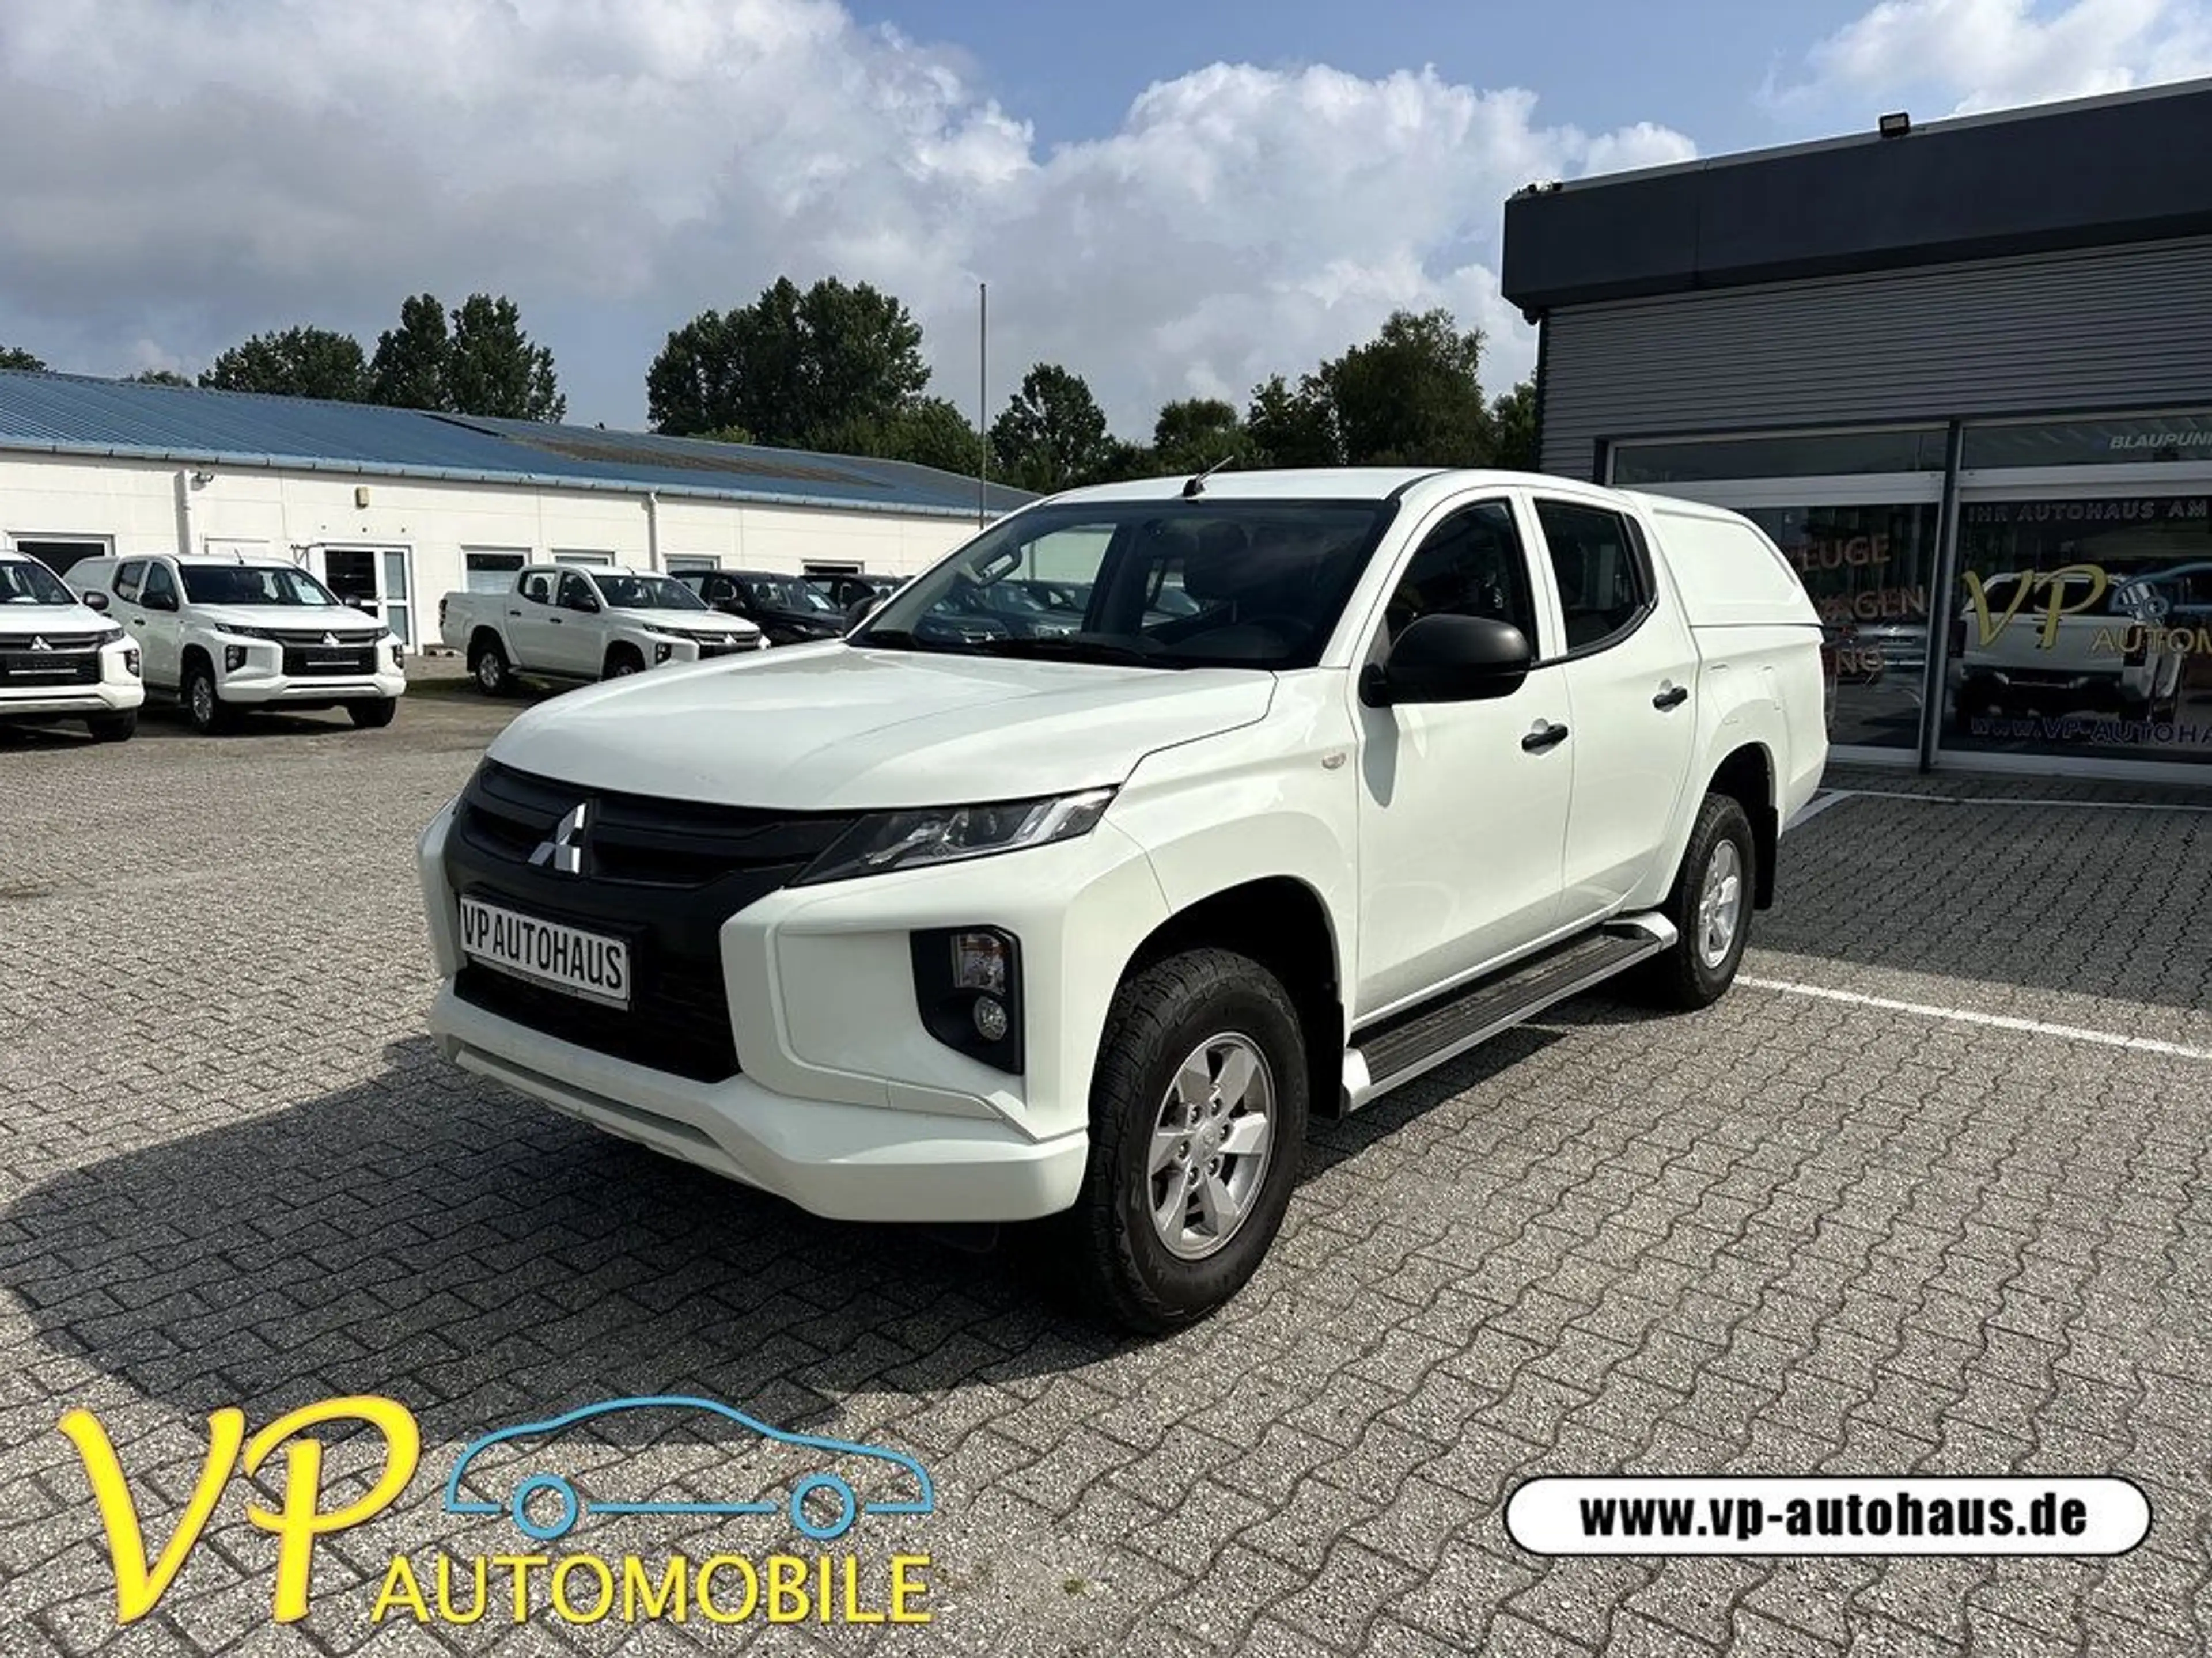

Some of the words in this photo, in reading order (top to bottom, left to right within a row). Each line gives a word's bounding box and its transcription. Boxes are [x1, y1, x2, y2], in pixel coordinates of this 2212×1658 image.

[2016, 500, 2155, 522] AUTOHAUS
[2168, 498, 2207, 518] AM
[1963, 564, 2107, 650] VP
[462, 902, 623, 990] VPAUTOHAUS
